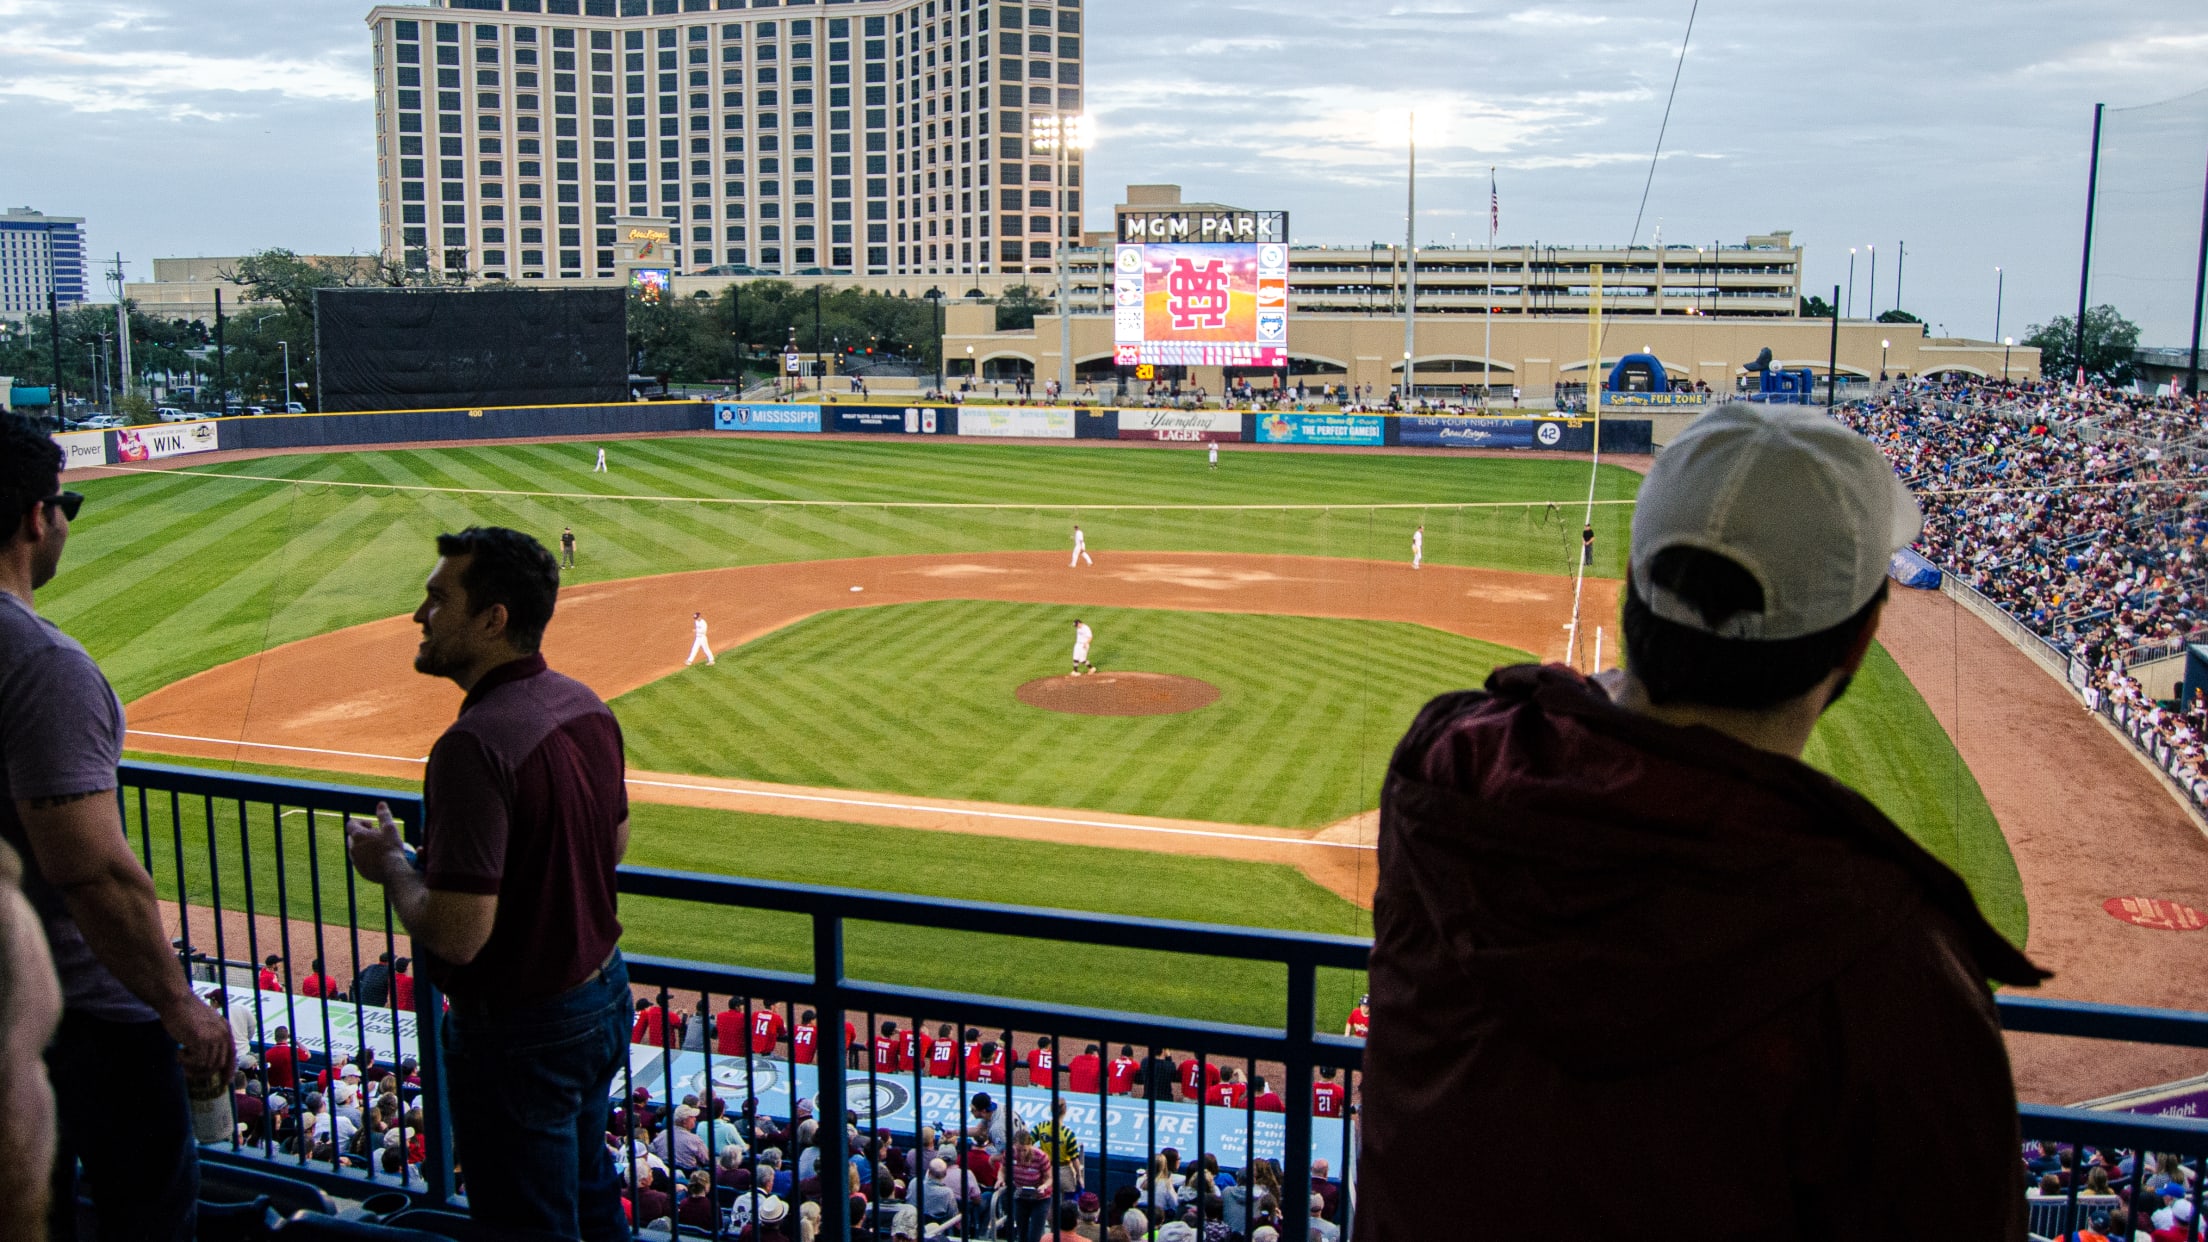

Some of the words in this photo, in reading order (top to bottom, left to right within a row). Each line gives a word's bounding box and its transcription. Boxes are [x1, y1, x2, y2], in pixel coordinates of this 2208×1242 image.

[1128, 218, 1188, 236] MGM
[1202, 218, 1272, 236] PARK
[1651, 394, 1671, 404] FUN
[1675, 394, 1702, 404] ZONE
[468, 409, 483, 417] 400
[752, 410, 818, 423] MISSISSIPPI
[1418, 418, 1438, 426] END
[1441, 418, 1467, 427] YOUR
[1470, 418, 1498, 427] NIGHT
[1502, 419, 1514, 427] AT
[1158, 429, 1200, 441] LAGER
[1302, 425, 1316, 435] THE
[1317, 425, 1348, 436] PERFECT
[1541, 427, 1557, 440] 42
[71, 444, 101, 457] Power
[154, 435, 184, 453] WIN.
[756, 1020, 769, 1035] 14
[795, 1032, 812, 1045] 44
[878, 1048, 887, 1064] 11
[934, 1047, 950, 1061] 20
[1038, 1055, 1052, 1069] 15
[1116, 1064, 1125, 1077] 7
[1318, 1096, 1331, 1112] 21
[1133, 1112, 1197, 1135] TRE
[1220, 1134, 1240, 1143] for
[1222, 1143, 1244, 1152] the
